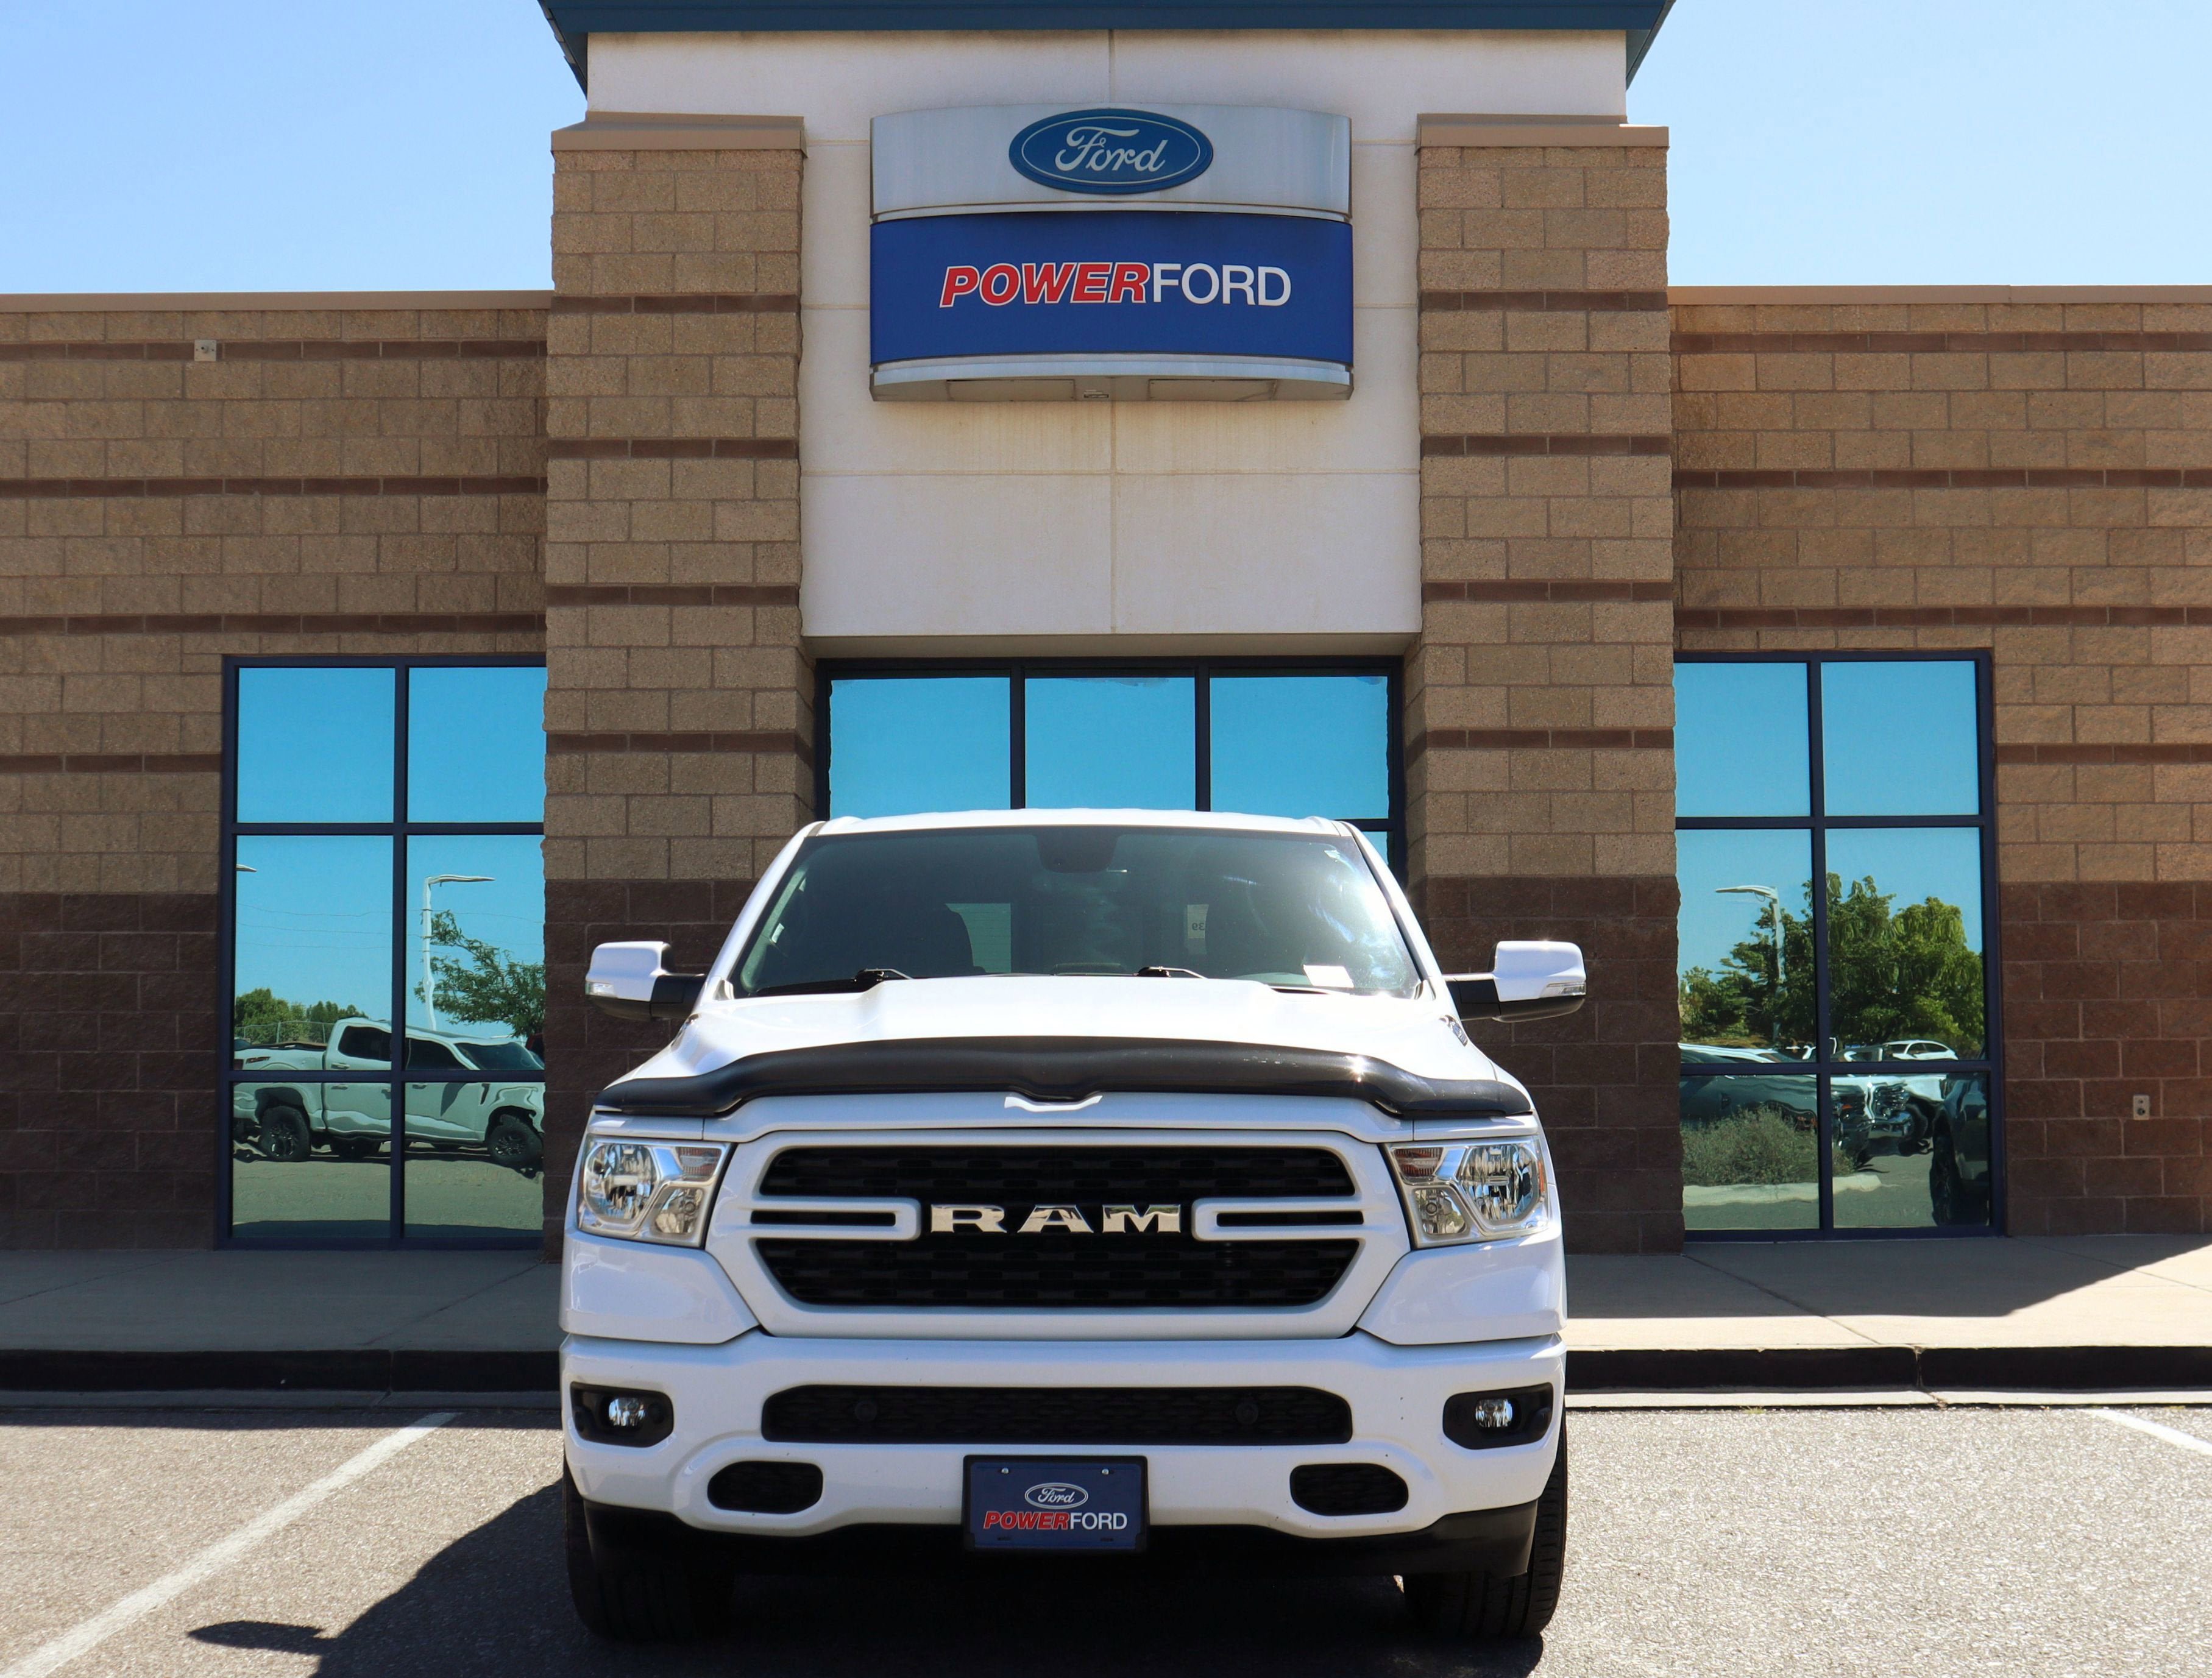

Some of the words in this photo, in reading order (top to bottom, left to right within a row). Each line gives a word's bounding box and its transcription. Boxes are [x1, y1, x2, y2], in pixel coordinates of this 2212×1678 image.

[1055, 126, 1168, 172] Ford
[931, 1204, 1181, 1233] RAM
[1038, 1487, 1074, 1503] Ford
